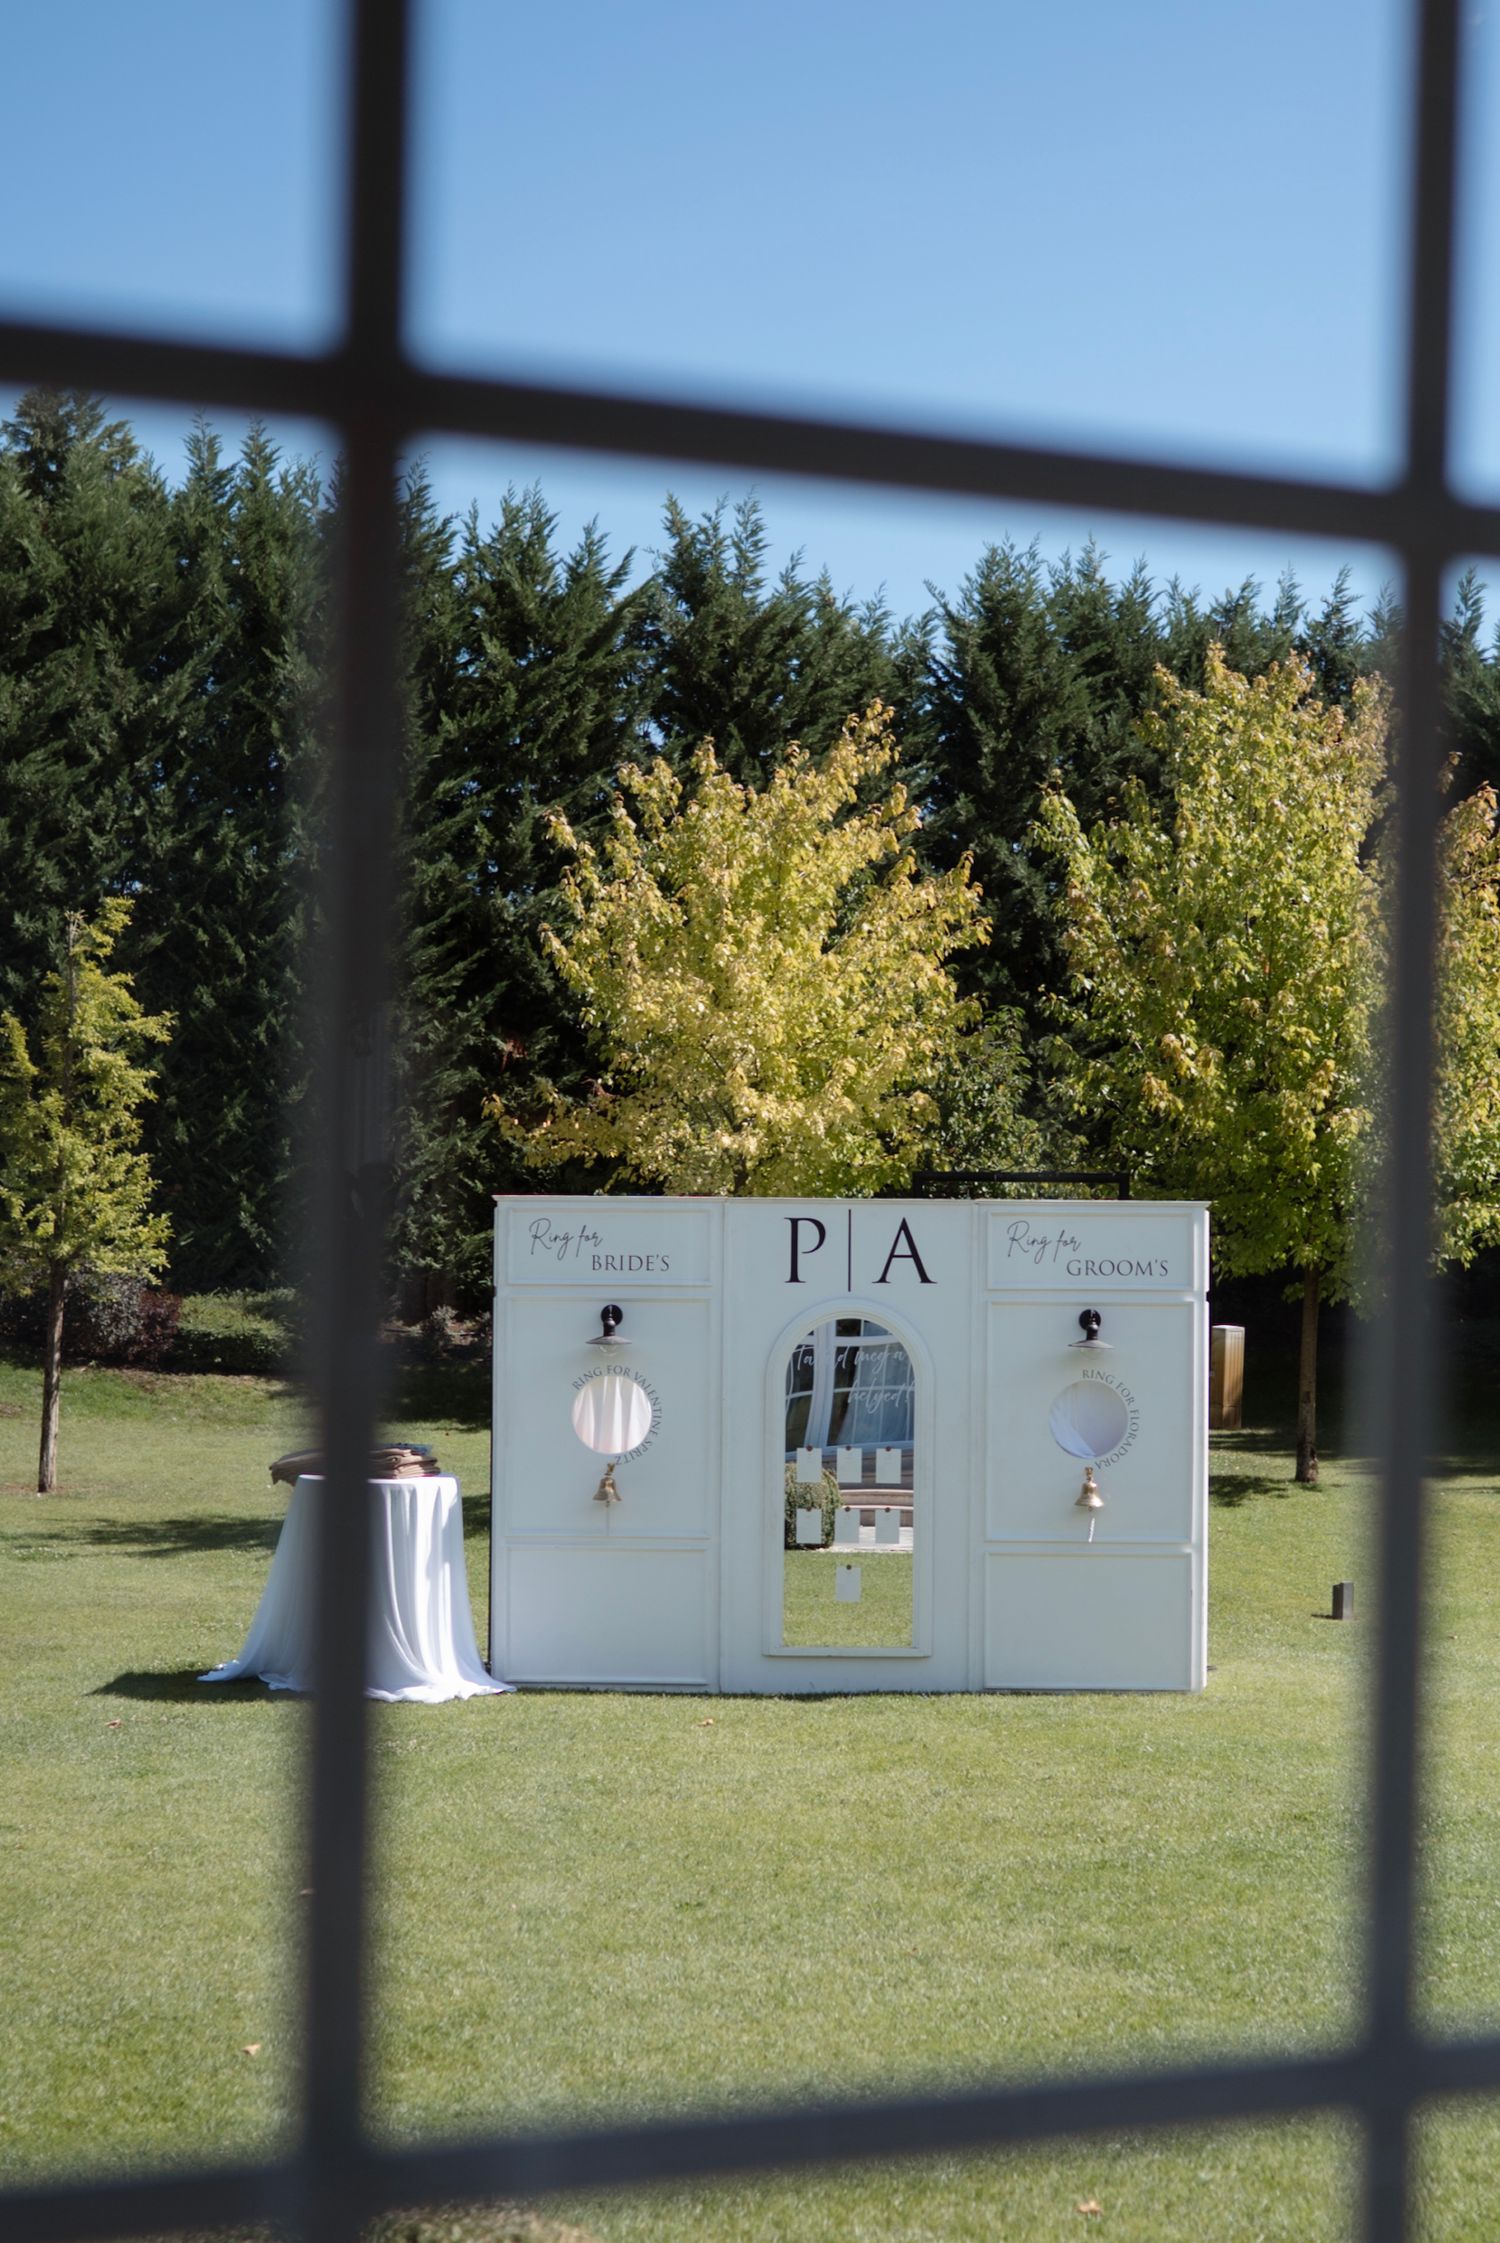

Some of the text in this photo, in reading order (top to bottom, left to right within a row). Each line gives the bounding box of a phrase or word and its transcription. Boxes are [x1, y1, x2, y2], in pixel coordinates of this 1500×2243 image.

[529, 1217, 604, 1261] Ring for
[784, 1216, 938, 1284] P A
[1006, 1220, 1082, 1264] Ring for
[592, 1254, 671, 1272] BRIDE'S
[1066, 1259, 1169, 1277] GROOM'S
[572, 1365, 663, 1466] RING FOR VALENTINE SPRITZ
[1082, 1369, 1140, 1470] RING FOR FLORADORA
